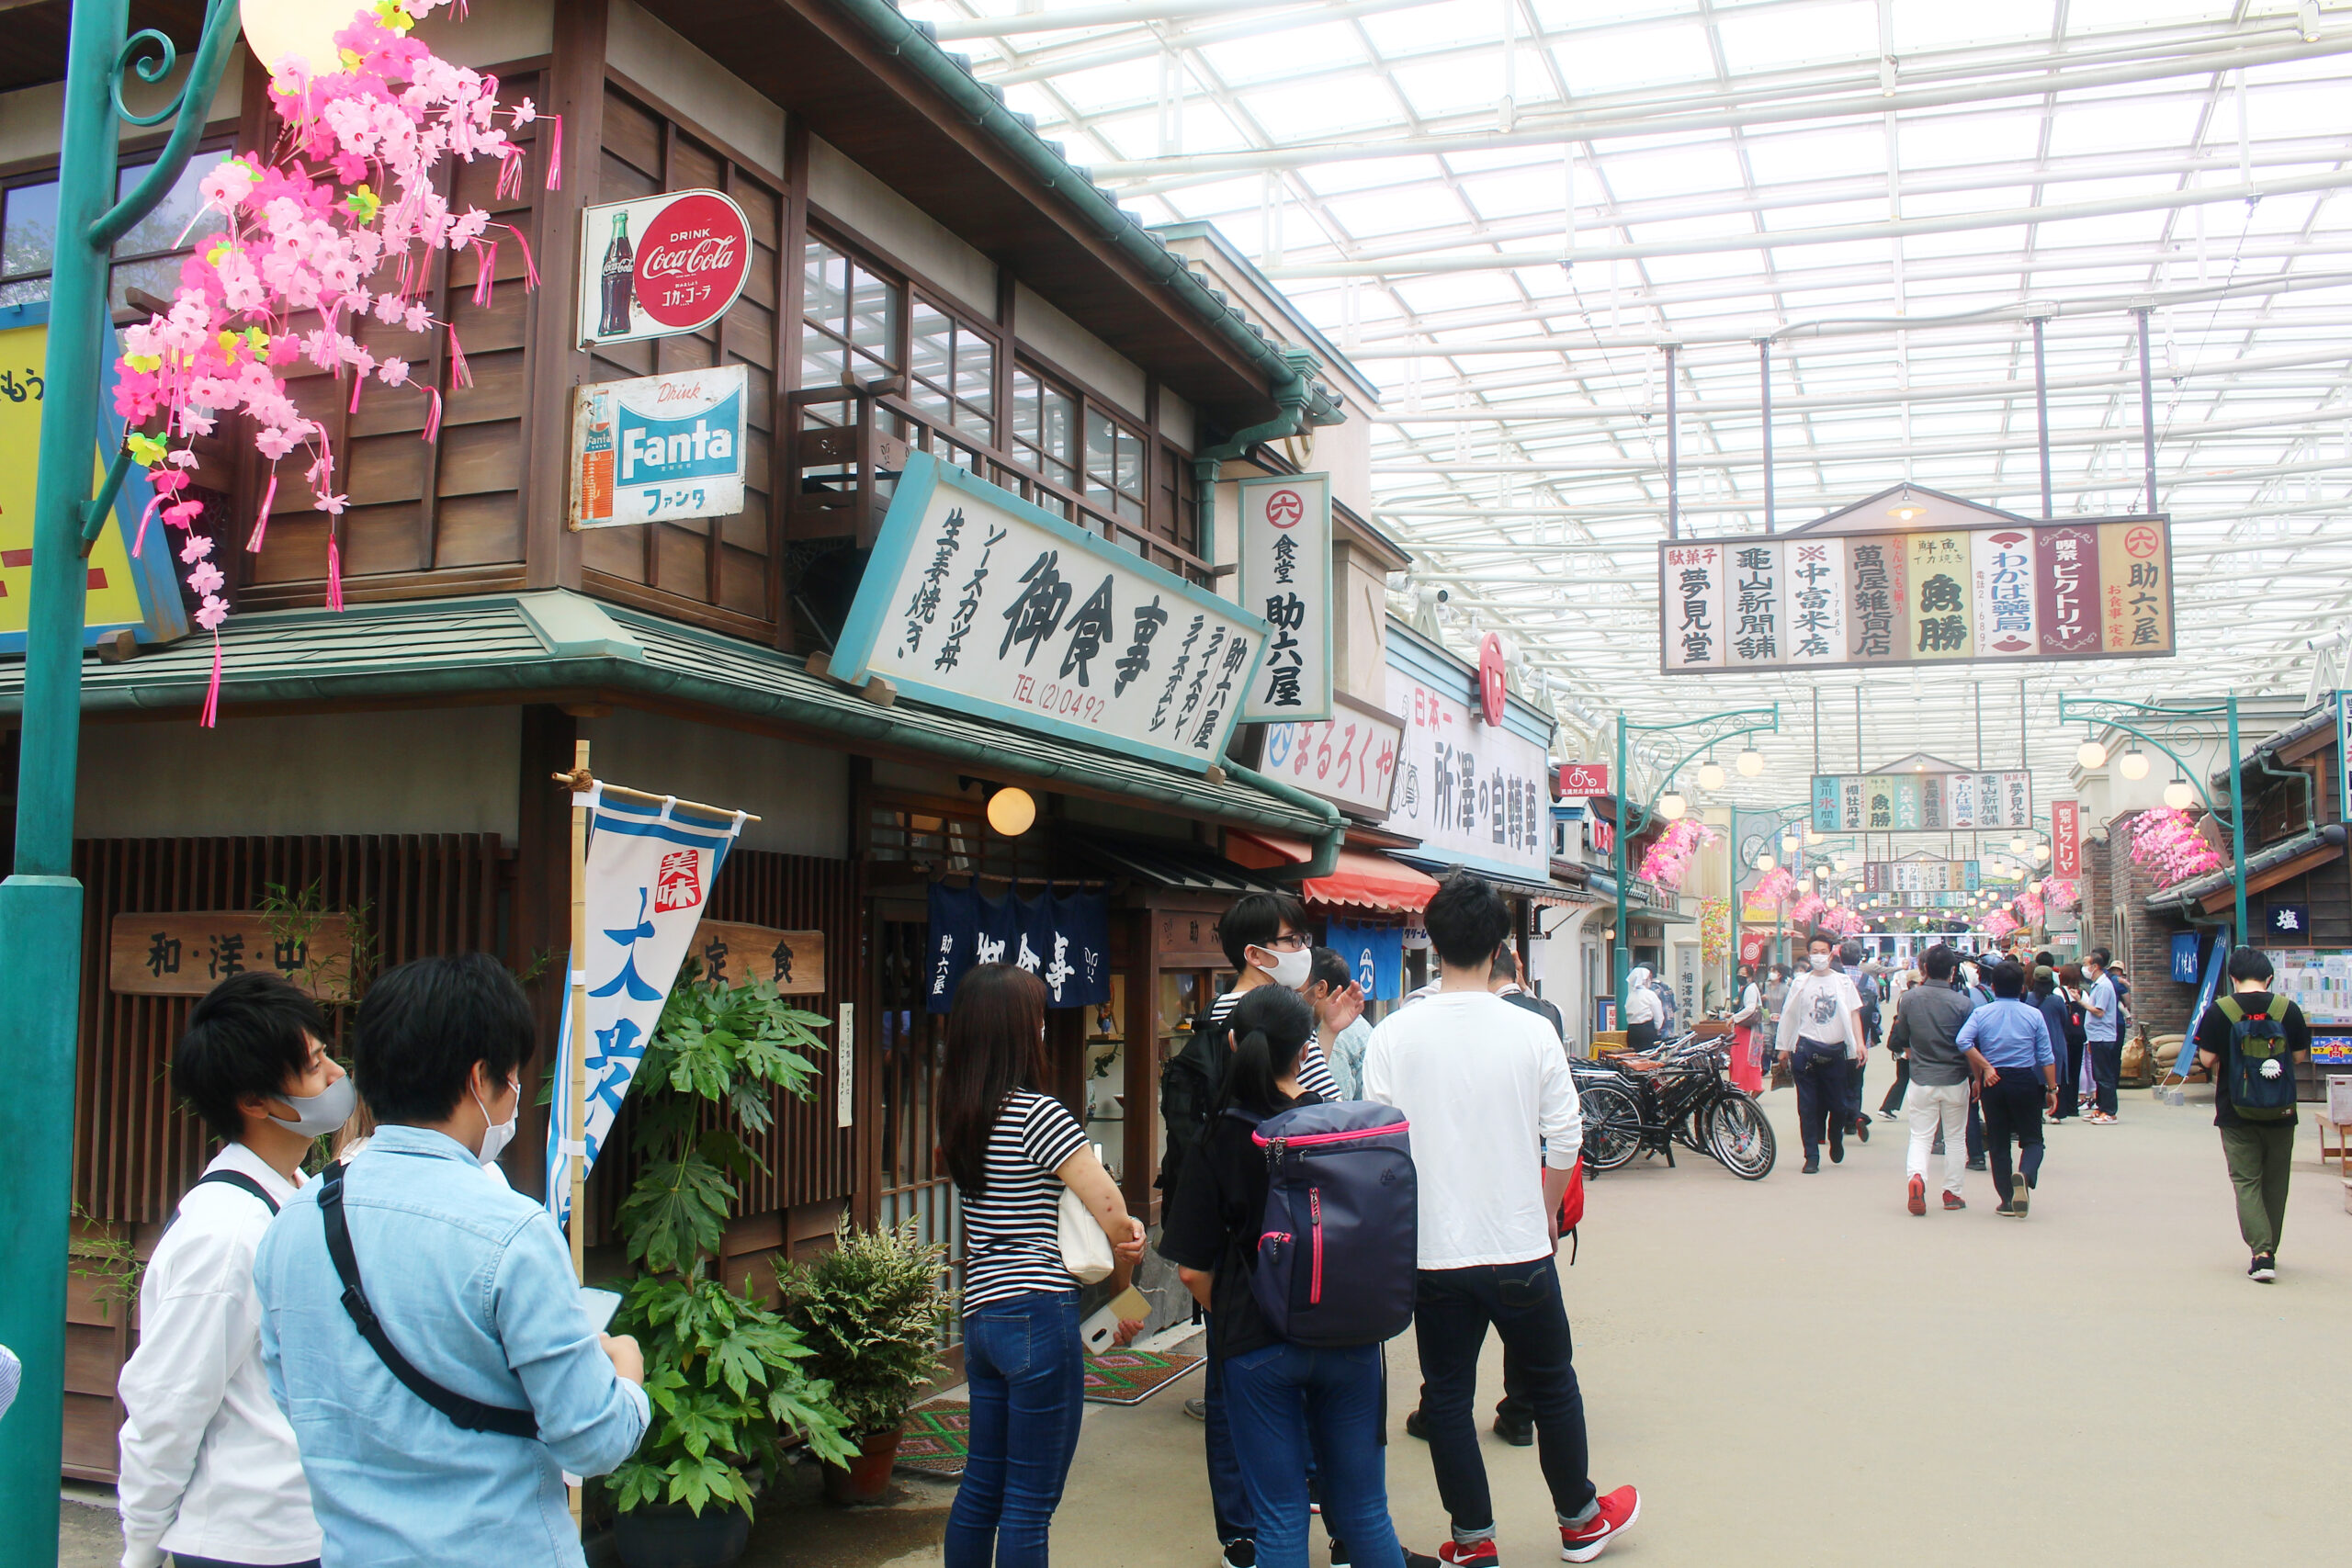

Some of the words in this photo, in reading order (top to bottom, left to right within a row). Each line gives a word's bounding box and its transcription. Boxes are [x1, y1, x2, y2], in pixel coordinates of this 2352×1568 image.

[642, 234, 737, 279] Coca-Cola
[670, 228, 711, 243] DRINK
[662, 285, 712, 307] コカ・コーラ
[657, 381, 701, 403] Drink
[586, 434, 612, 446] Fanta
[623, 419, 732, 479] Fanta
[643, 489, 706, 516] ファンタ
[1271, 534, 1299, 584] 食堂
[1668, 547, 1717, 566] 駄菓子
[1917, 538, 1958, 553] 鮮魚
[935, 525, 1007, 674] ソースカツ丼
[999, 549, 1169, 699] 御食事
[1678, 567, 1713, 664] 夢見堂
[1792, 562, 1836, 657] 中富米店
[1917, 573, 1967, 652] 魚勝
[2108, 584, 2123, 620] お食事
[2126, 561, 2161, 646] 助六屋
[1264, 591, 1306, 706] 助六屋
[2109, 624, 2124, 648] 定食
[1013, 673, 1034, 705] TEL
[1148, 614, 1204, 732] ライスオムレツ
[1174, 626, 1226, 741] ライスカレー
[1192, 637, 1248, 750] 助六屋
[1414, 687, 1453, 732] 日本一
[1294, 716, 1394, 798] まるろくや
[2008, 783, 2026, 826] 夢見堂
[656, 850, 700, 909] 美味
[2276, 908, 2300, 930] 塩
[703, 935, 796, 985] 定食
[932, 933, 954, 995] 助六屋
